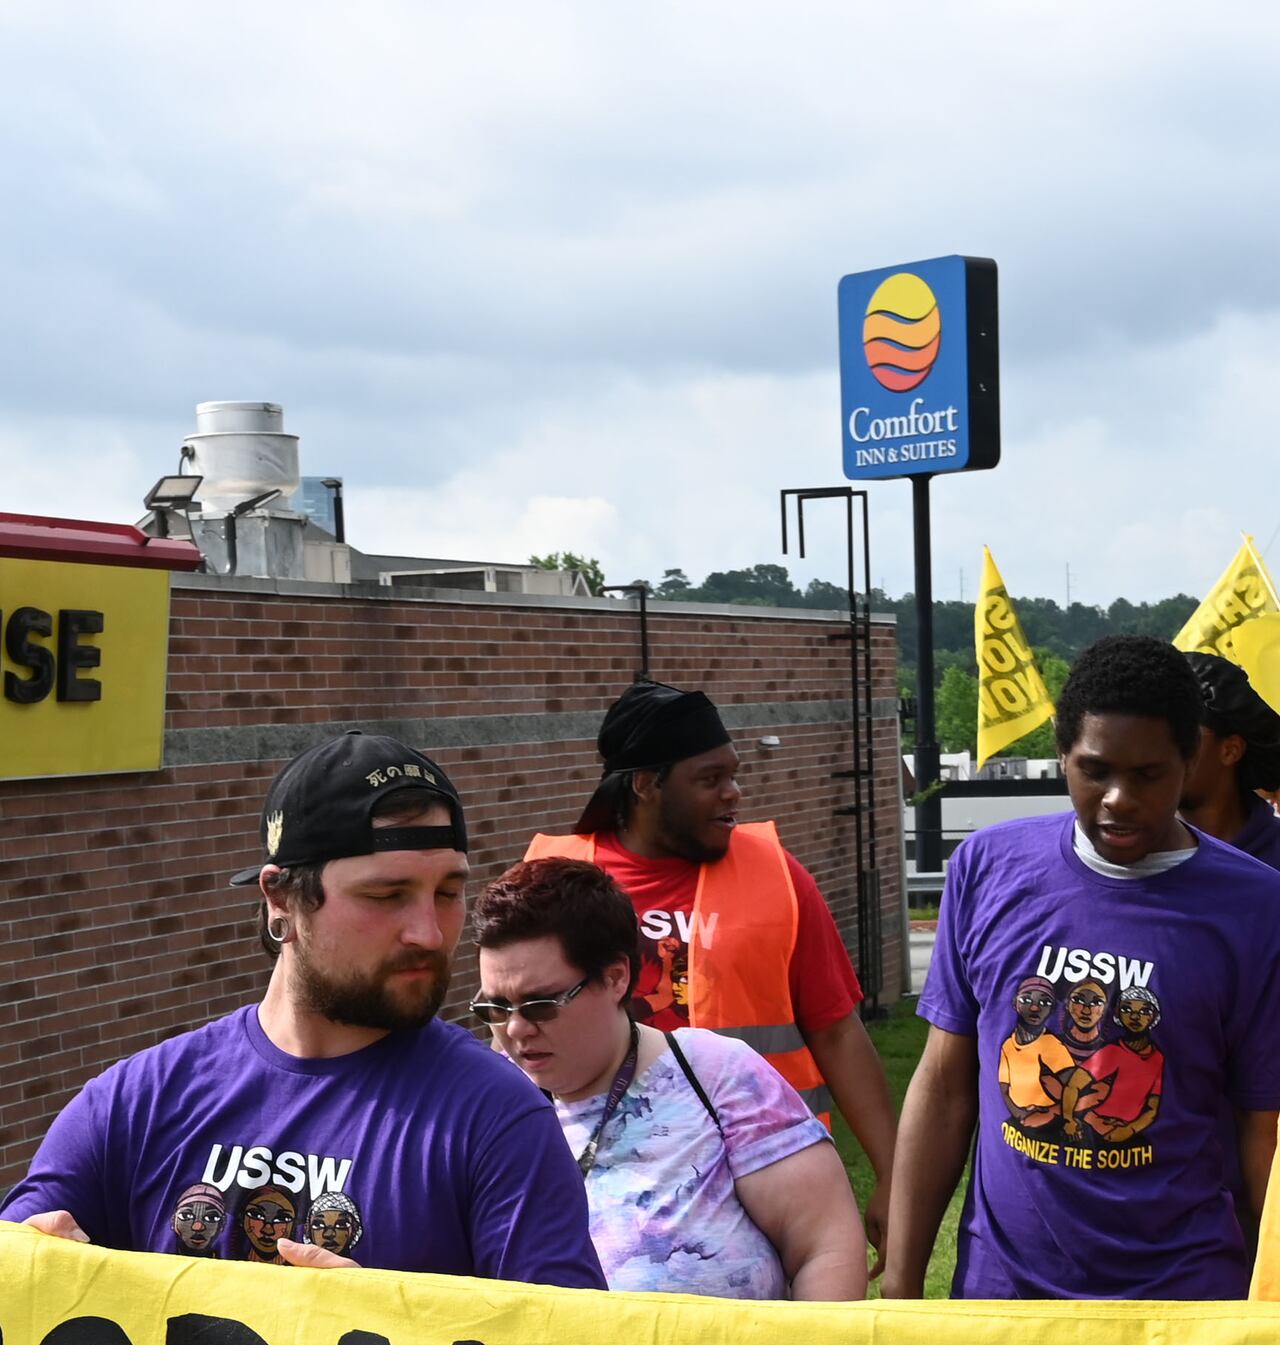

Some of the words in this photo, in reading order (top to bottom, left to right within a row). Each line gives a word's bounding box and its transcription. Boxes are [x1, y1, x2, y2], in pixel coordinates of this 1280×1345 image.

[849, 398, 958, 442] Comfort
[856, 448, 886, 467] INN
[888, 448, 898, 463] &
[900, 439, 956, 461] SUITES
[640, 909, 718, 950] SW
[1037, 946, 1154, 991] USSW
[1001, 1121, 1058, 1165] ORGANIZE
[1064, 1146, 1092, 1169] THE
[1097, 1145, 1152, 1168] SOUTH
[201, 1144, 352, 1200] USSW
